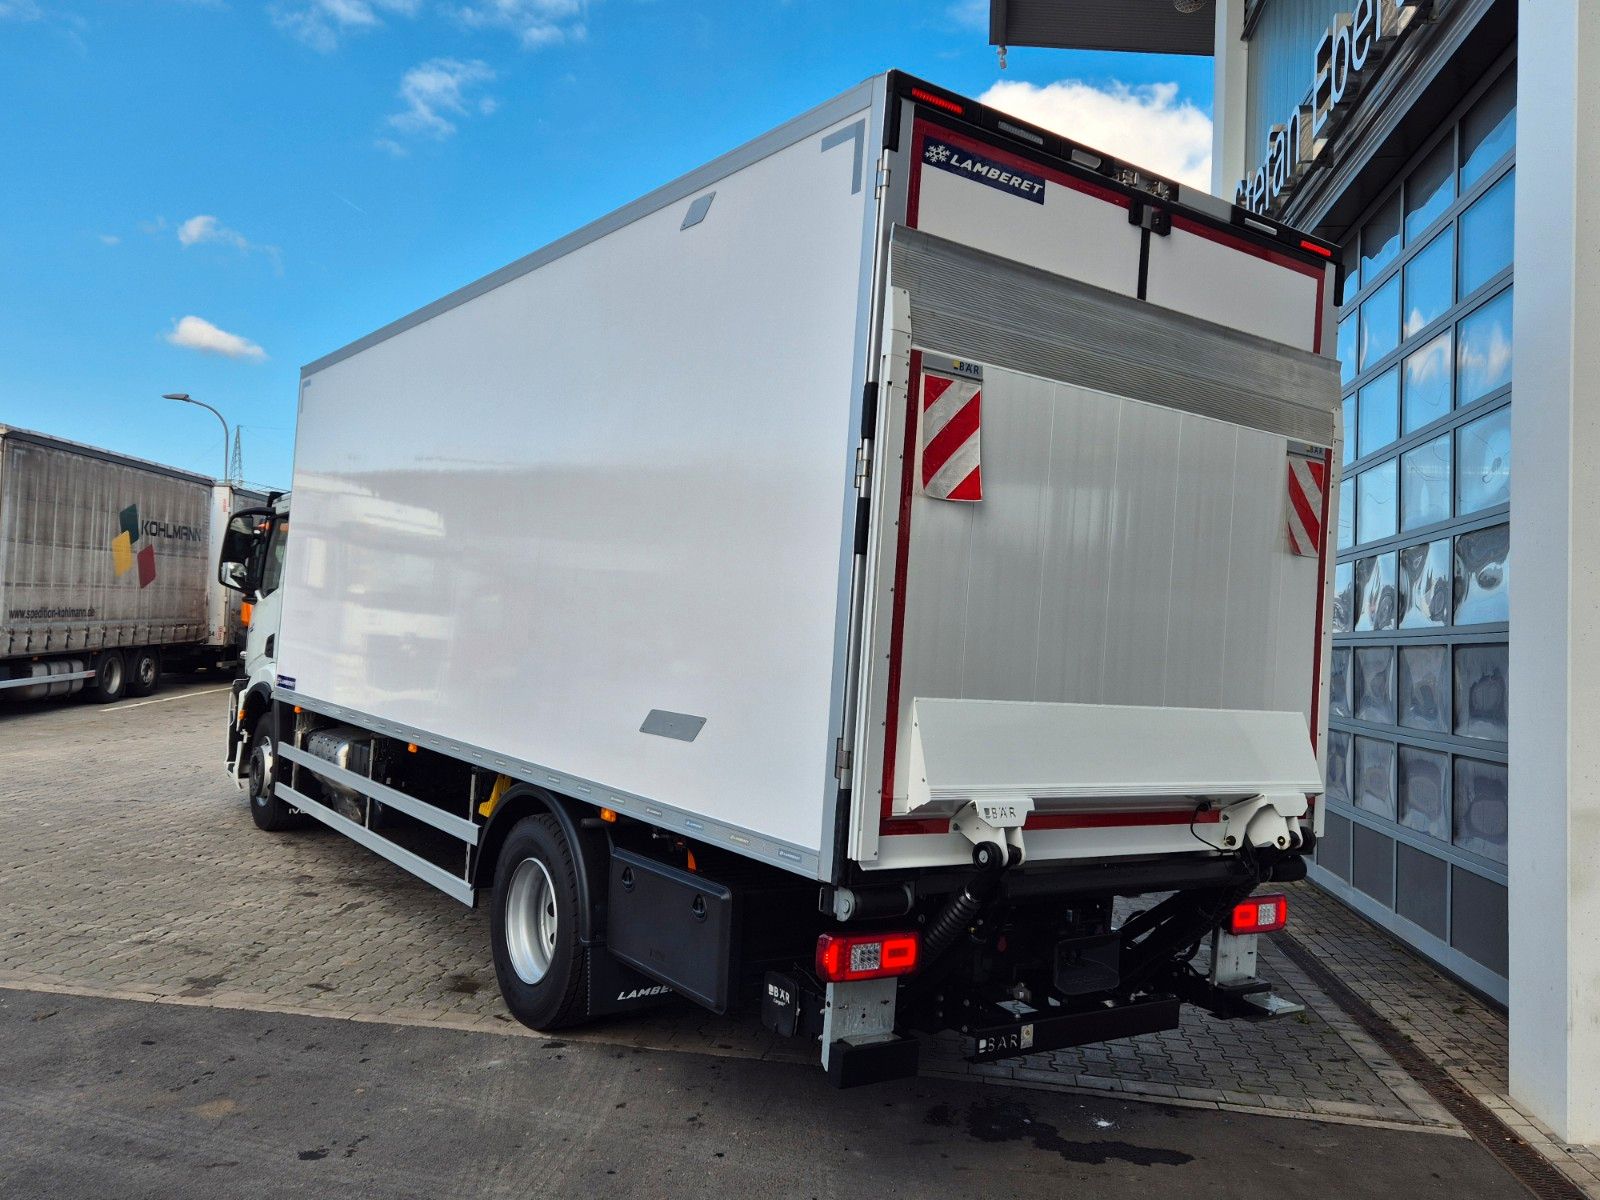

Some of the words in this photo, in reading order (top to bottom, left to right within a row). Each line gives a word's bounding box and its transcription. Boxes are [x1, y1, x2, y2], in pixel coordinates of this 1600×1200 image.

[949, 154, 1043, 194] LAMBERET
[959, 361, 979, 375] BÄR
[141, 519, 201, 542] KOHLMANN
[8, 605, 96, 621] www.spedition-kohlmann.de
[616, 985, 673, 1001] LAMBE
